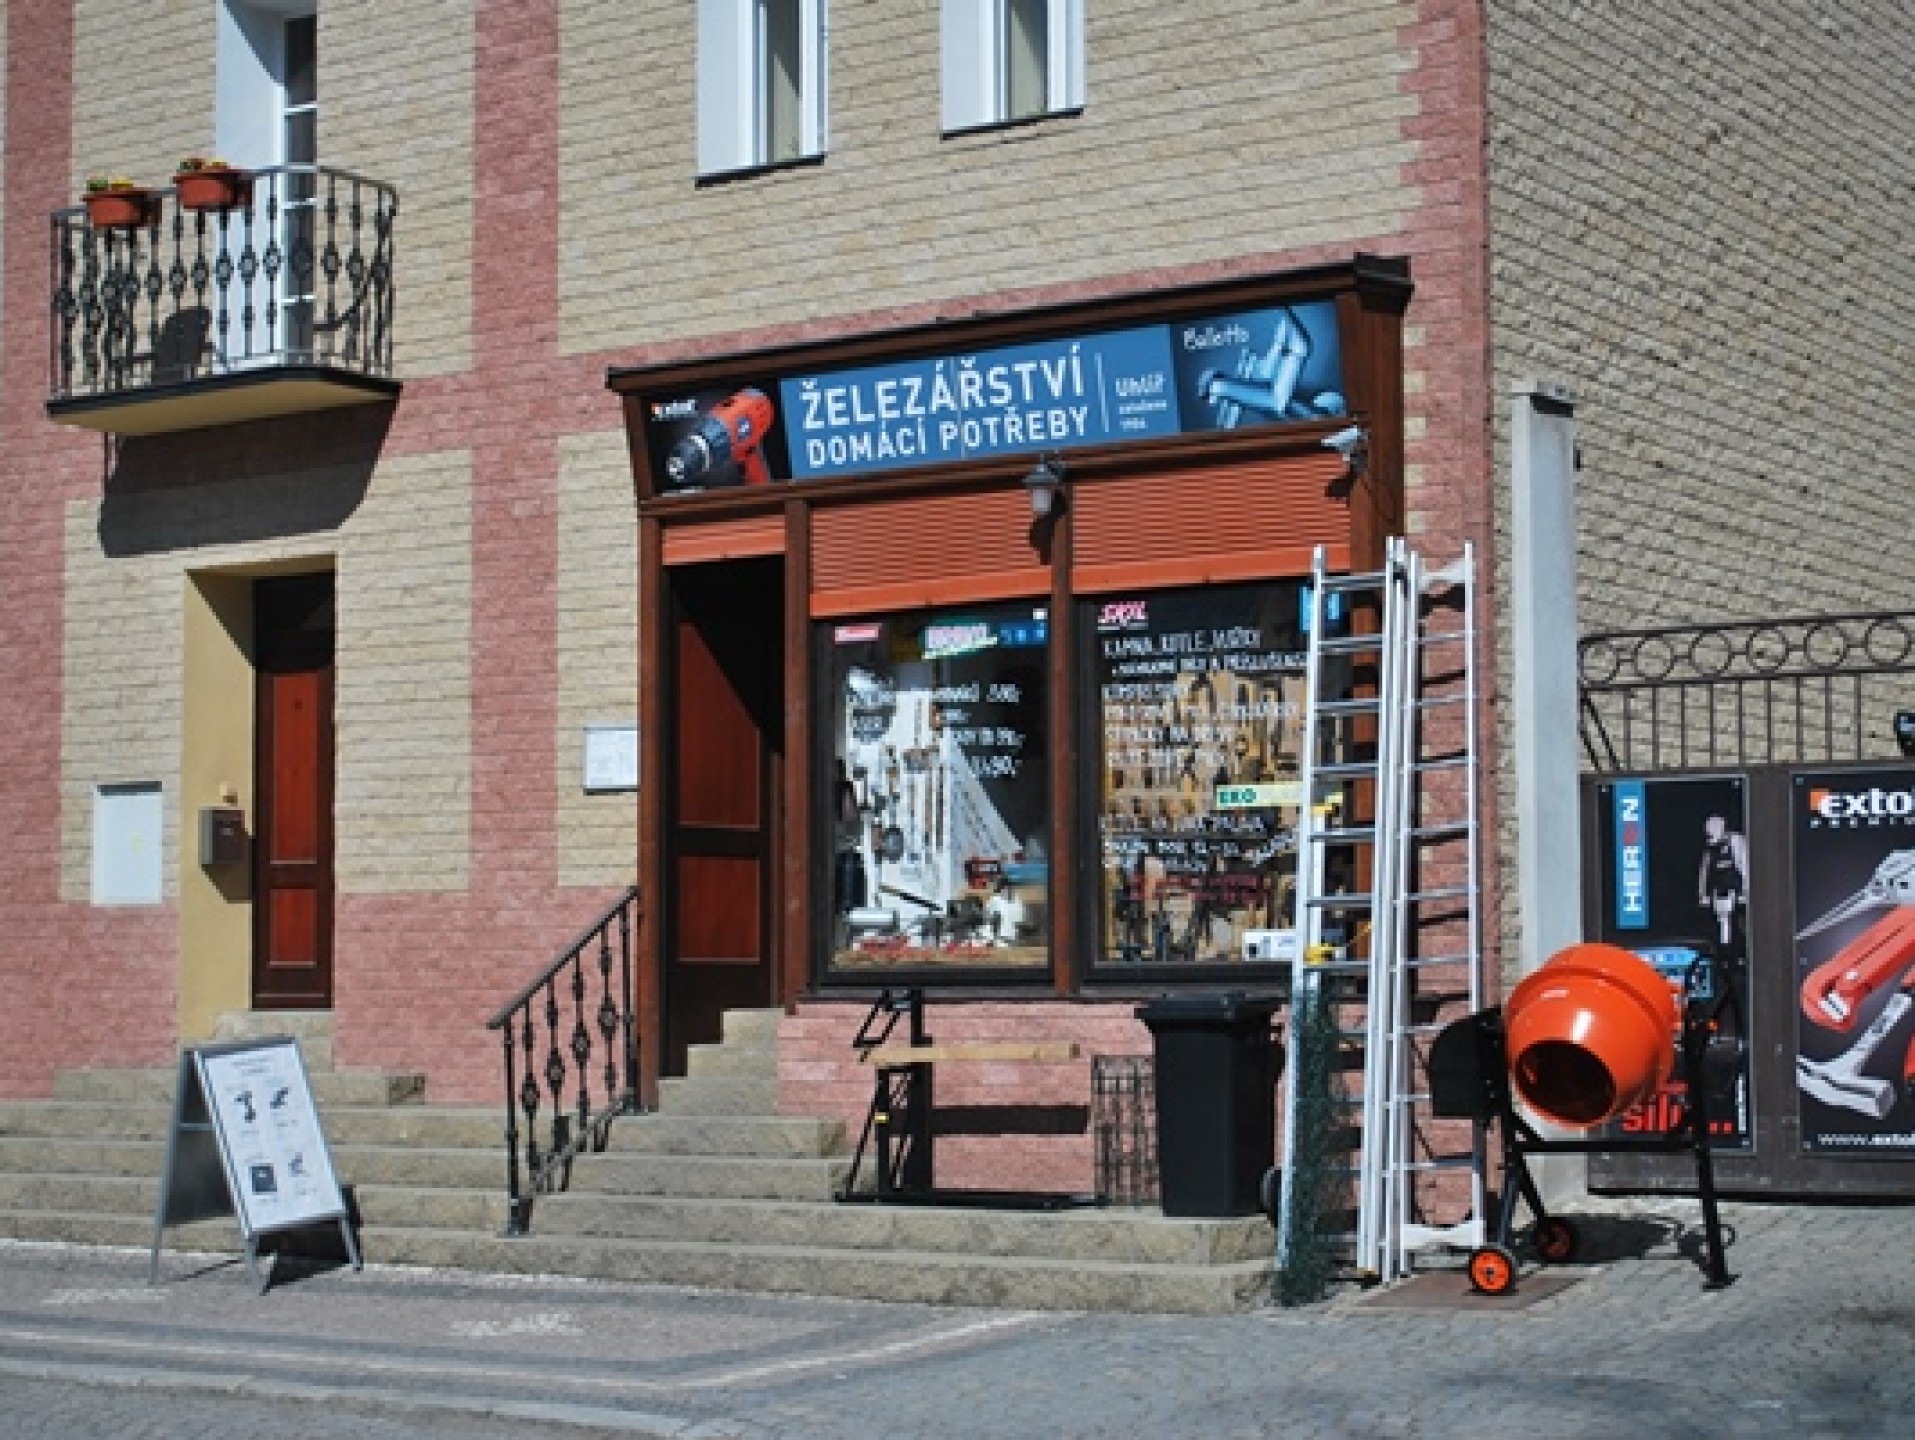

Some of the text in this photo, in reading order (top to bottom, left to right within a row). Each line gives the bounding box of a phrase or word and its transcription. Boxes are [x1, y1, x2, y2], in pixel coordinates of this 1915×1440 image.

[800, 342, 1085, 430] ŽELEZÁŘSTVÍ
[806, 404, 1089, 468] DOMÁCÍ POTŘEBY
[1817, 787, 1915, 817] exto
